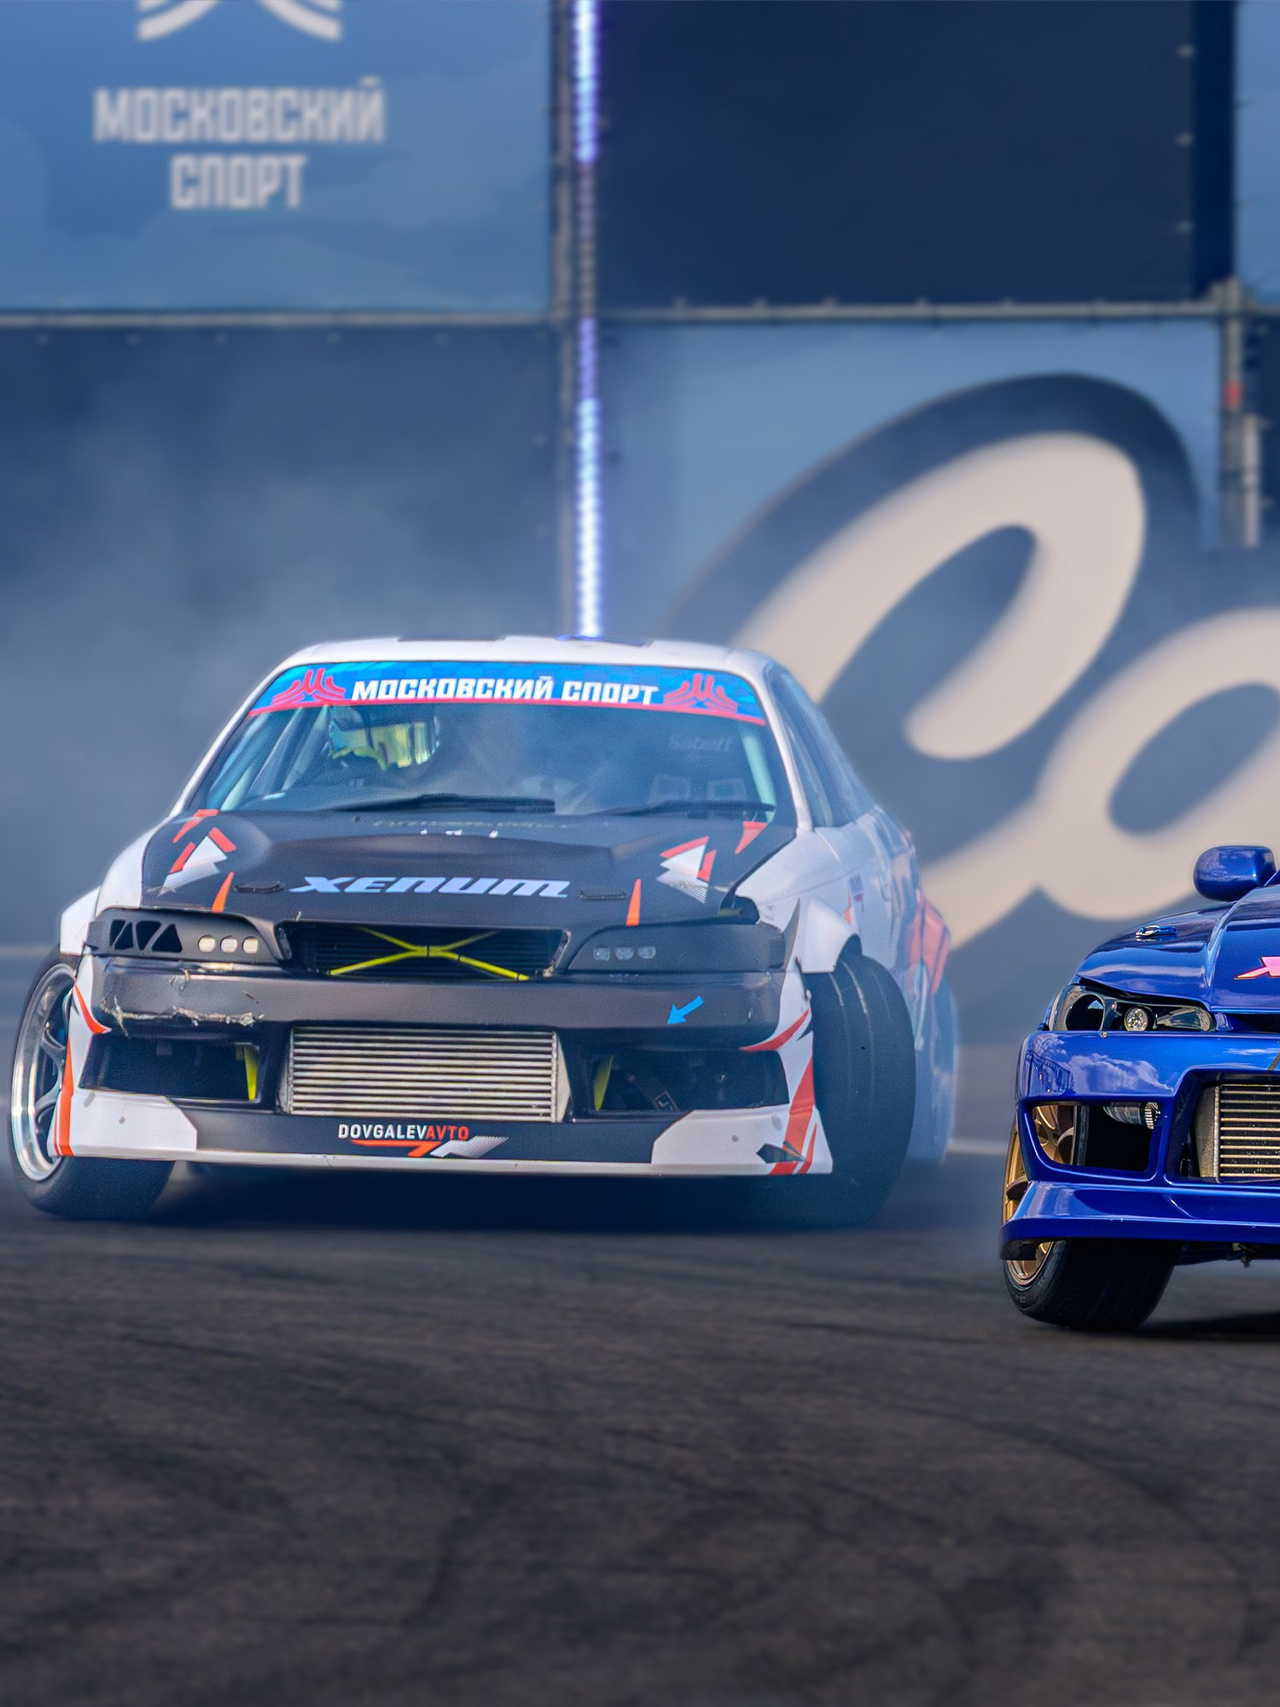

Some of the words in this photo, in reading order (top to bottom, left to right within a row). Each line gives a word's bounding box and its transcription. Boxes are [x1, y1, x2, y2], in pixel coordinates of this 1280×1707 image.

[94, 76, 385, 144] МОСКОВСКИЙ
[170, 154, 307, 210] СПОРТ
[351, 676, 553, 702] МОСКОВСКИЙ
[562, 682, 659, 705] СПОРТ
[338, 1123, 470, 1141] DOVGALEVAVTO
